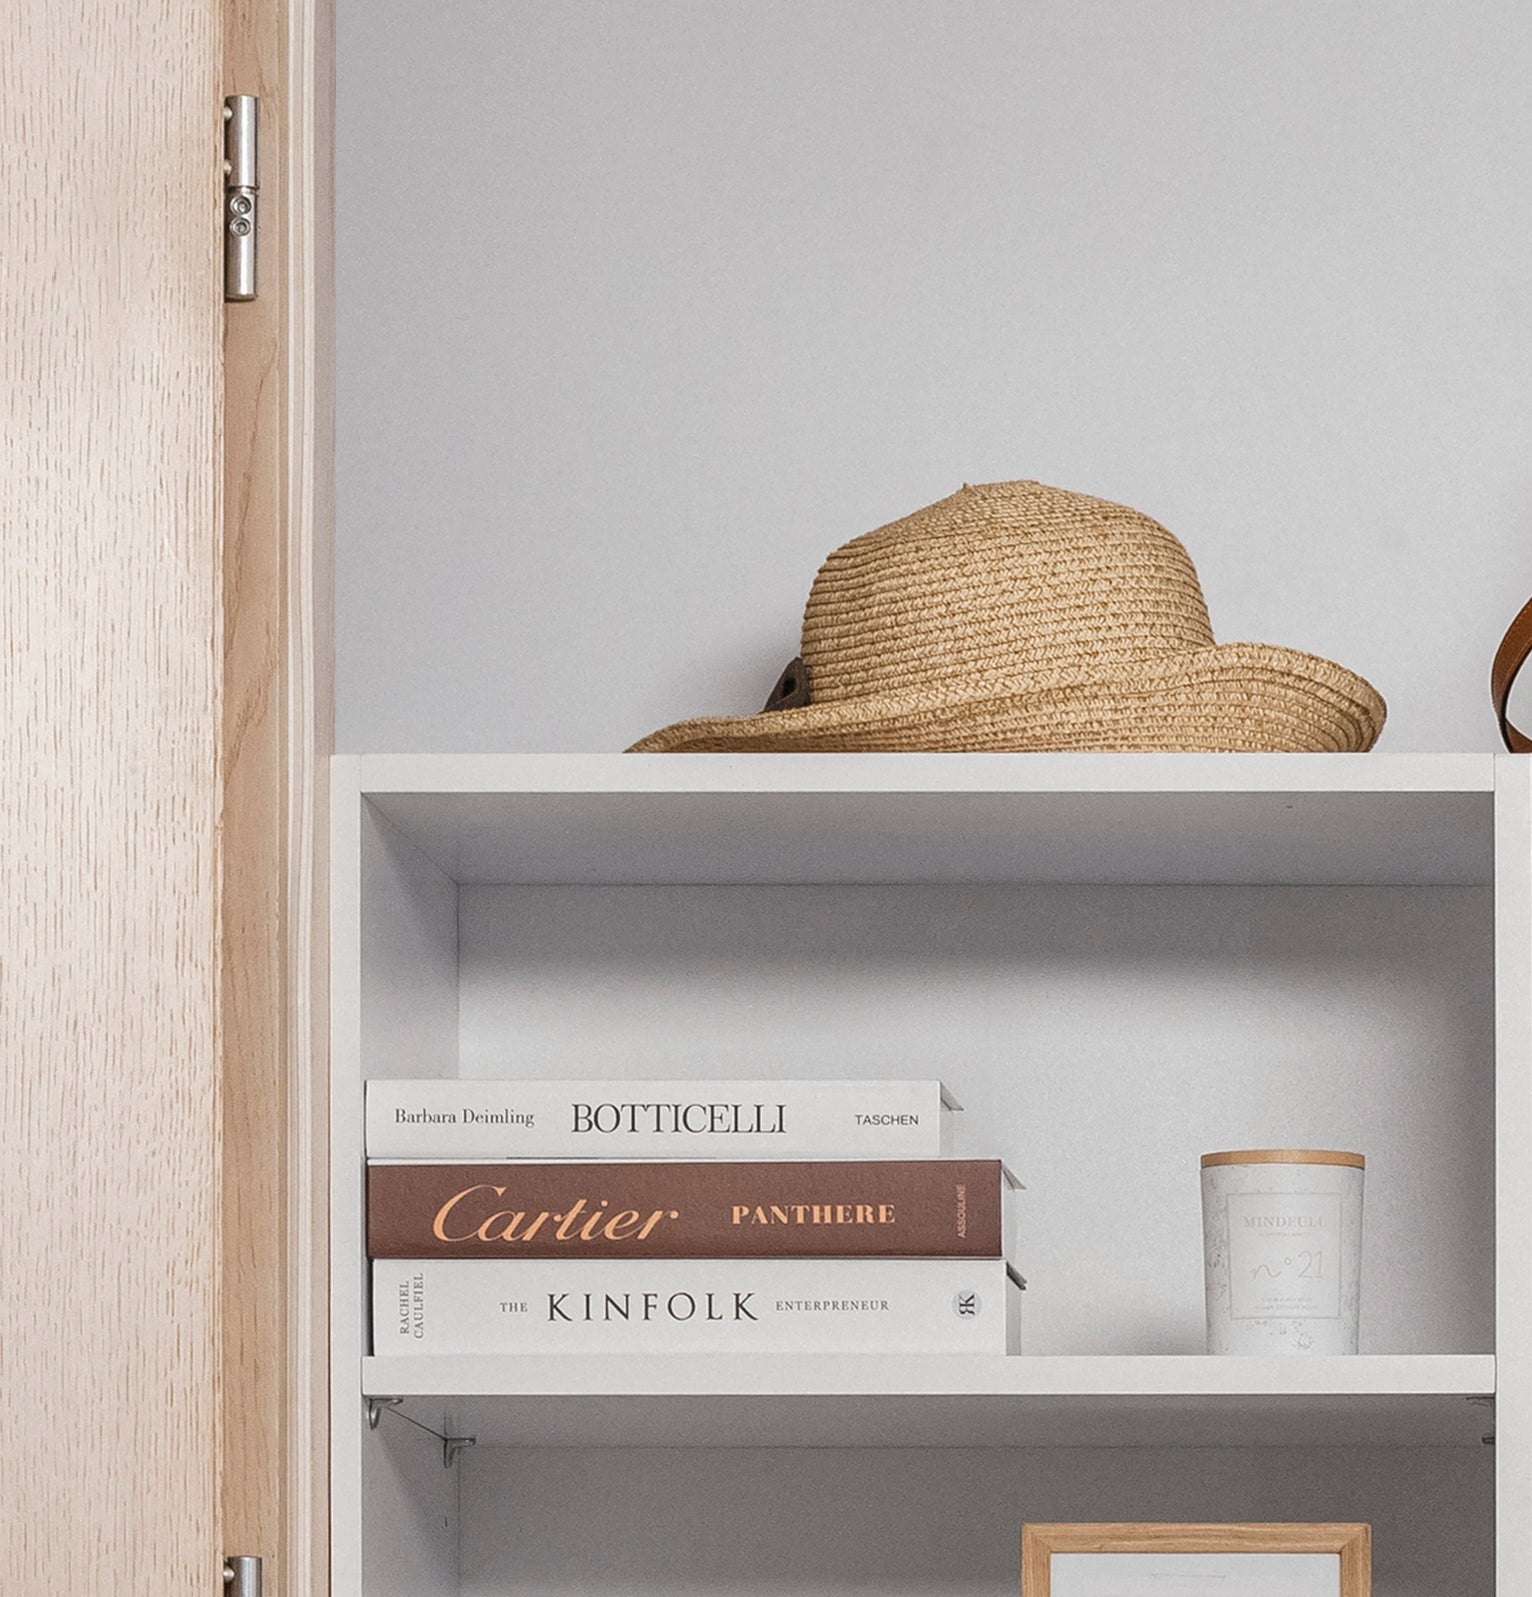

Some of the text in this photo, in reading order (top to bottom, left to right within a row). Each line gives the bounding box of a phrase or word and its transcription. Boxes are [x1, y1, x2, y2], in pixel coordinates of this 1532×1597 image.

[394, 1103, 919, 1134] Barbara Deimling BOTTICELLI TASCHEN
[432, 1184, 896, 1242] Cartier PANTHERE
[956, 1184, 967, 1239] ASSOULINE
[399, 1280, 410, 1335] RACHEL
[413, 1272, 424, 1340] CAULFIEL
[500, 1291, 889, 1322] THE KINFOLK ENTERPRENEUR
